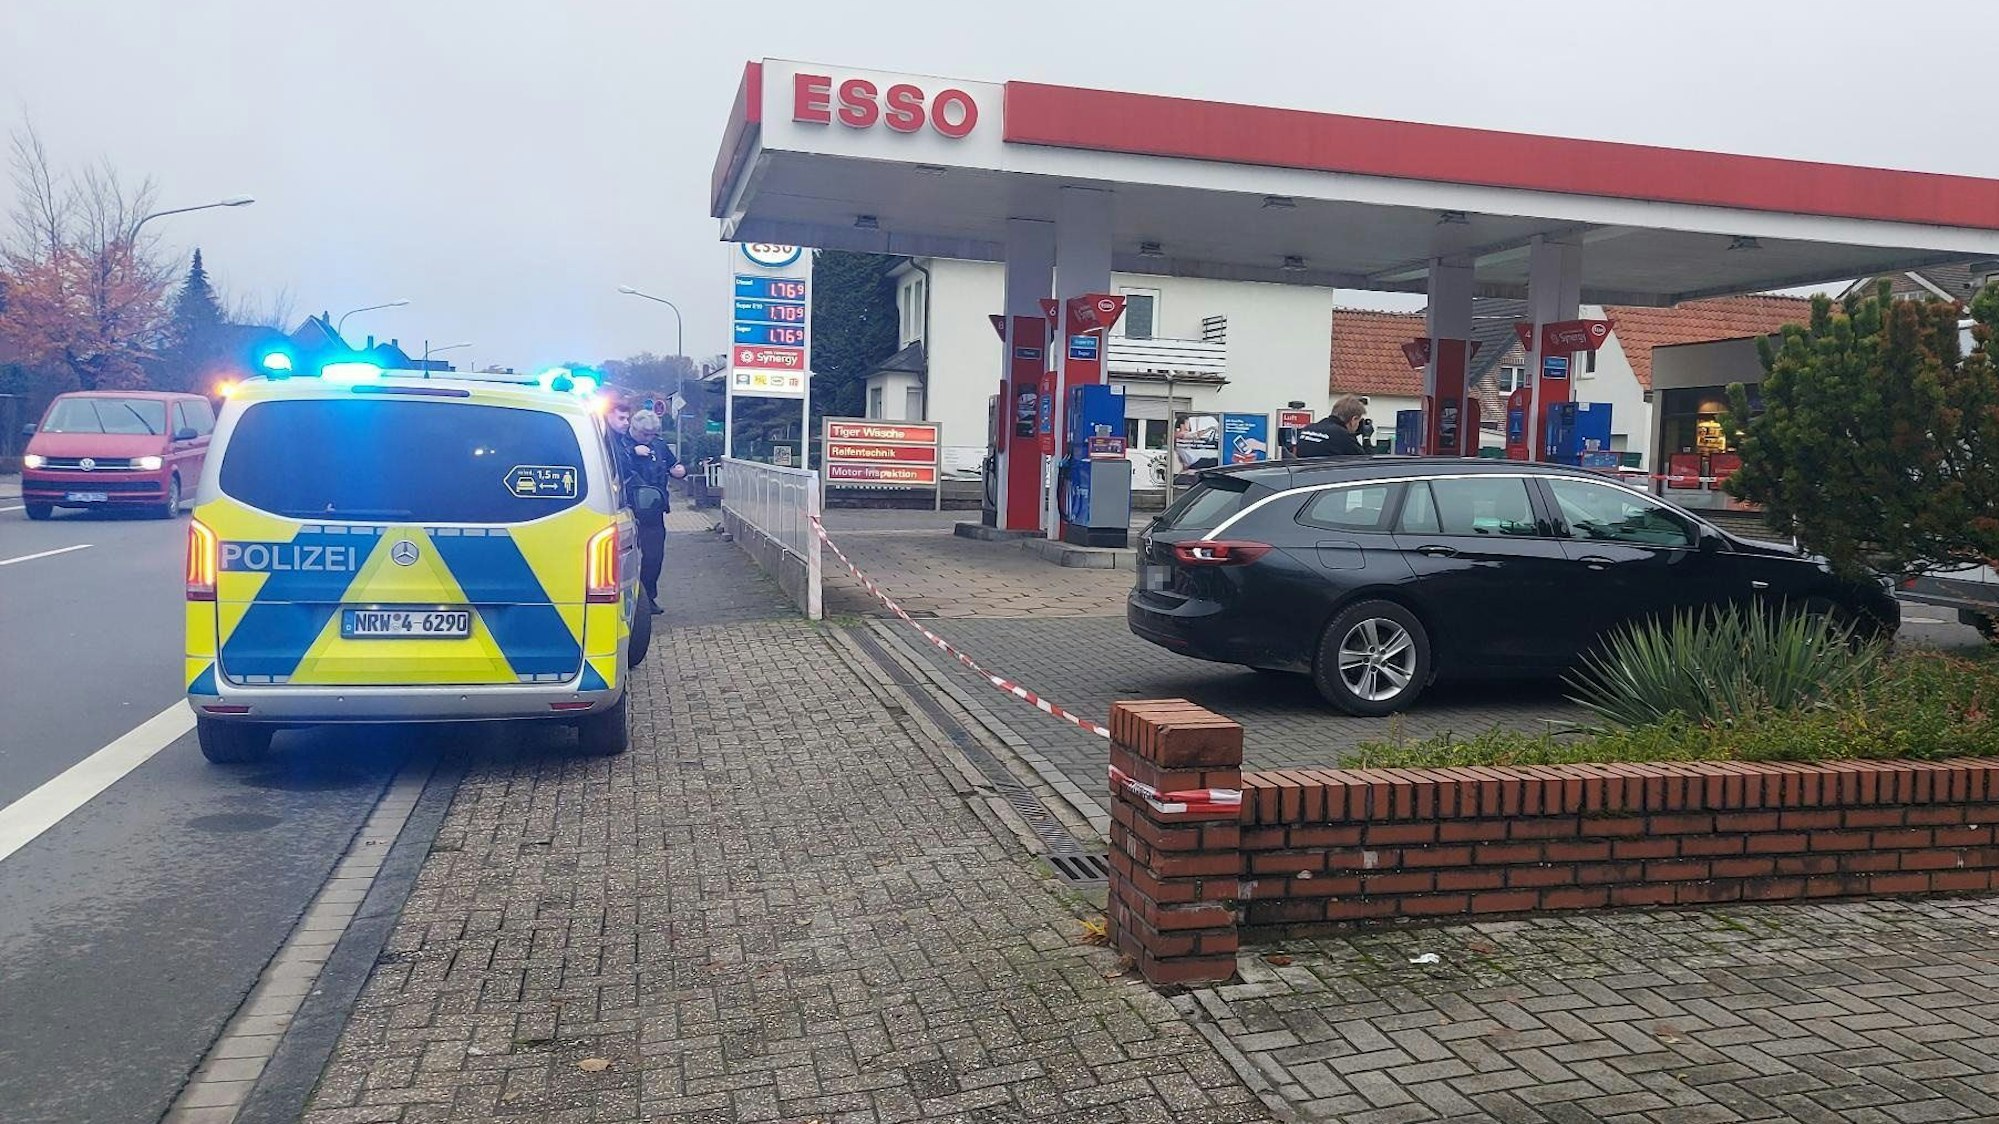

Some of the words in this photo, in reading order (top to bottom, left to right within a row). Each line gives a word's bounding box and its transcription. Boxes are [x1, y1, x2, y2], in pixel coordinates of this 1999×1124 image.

[792, 73, 979, 139] ESSO
[756, 352, 798, 367] Synergy
[832, 426, 861, 438] Tiger
[832, 446, 896, 457] Reifentechnik
[537, 469, 551, 480] 1,5
[832, 467, 863, 477] Motor
[221, 544, 356, 571] POLIZEI
[355, 613, 391, 632] NRW
[401, 613, 467, 632] 4-6290
